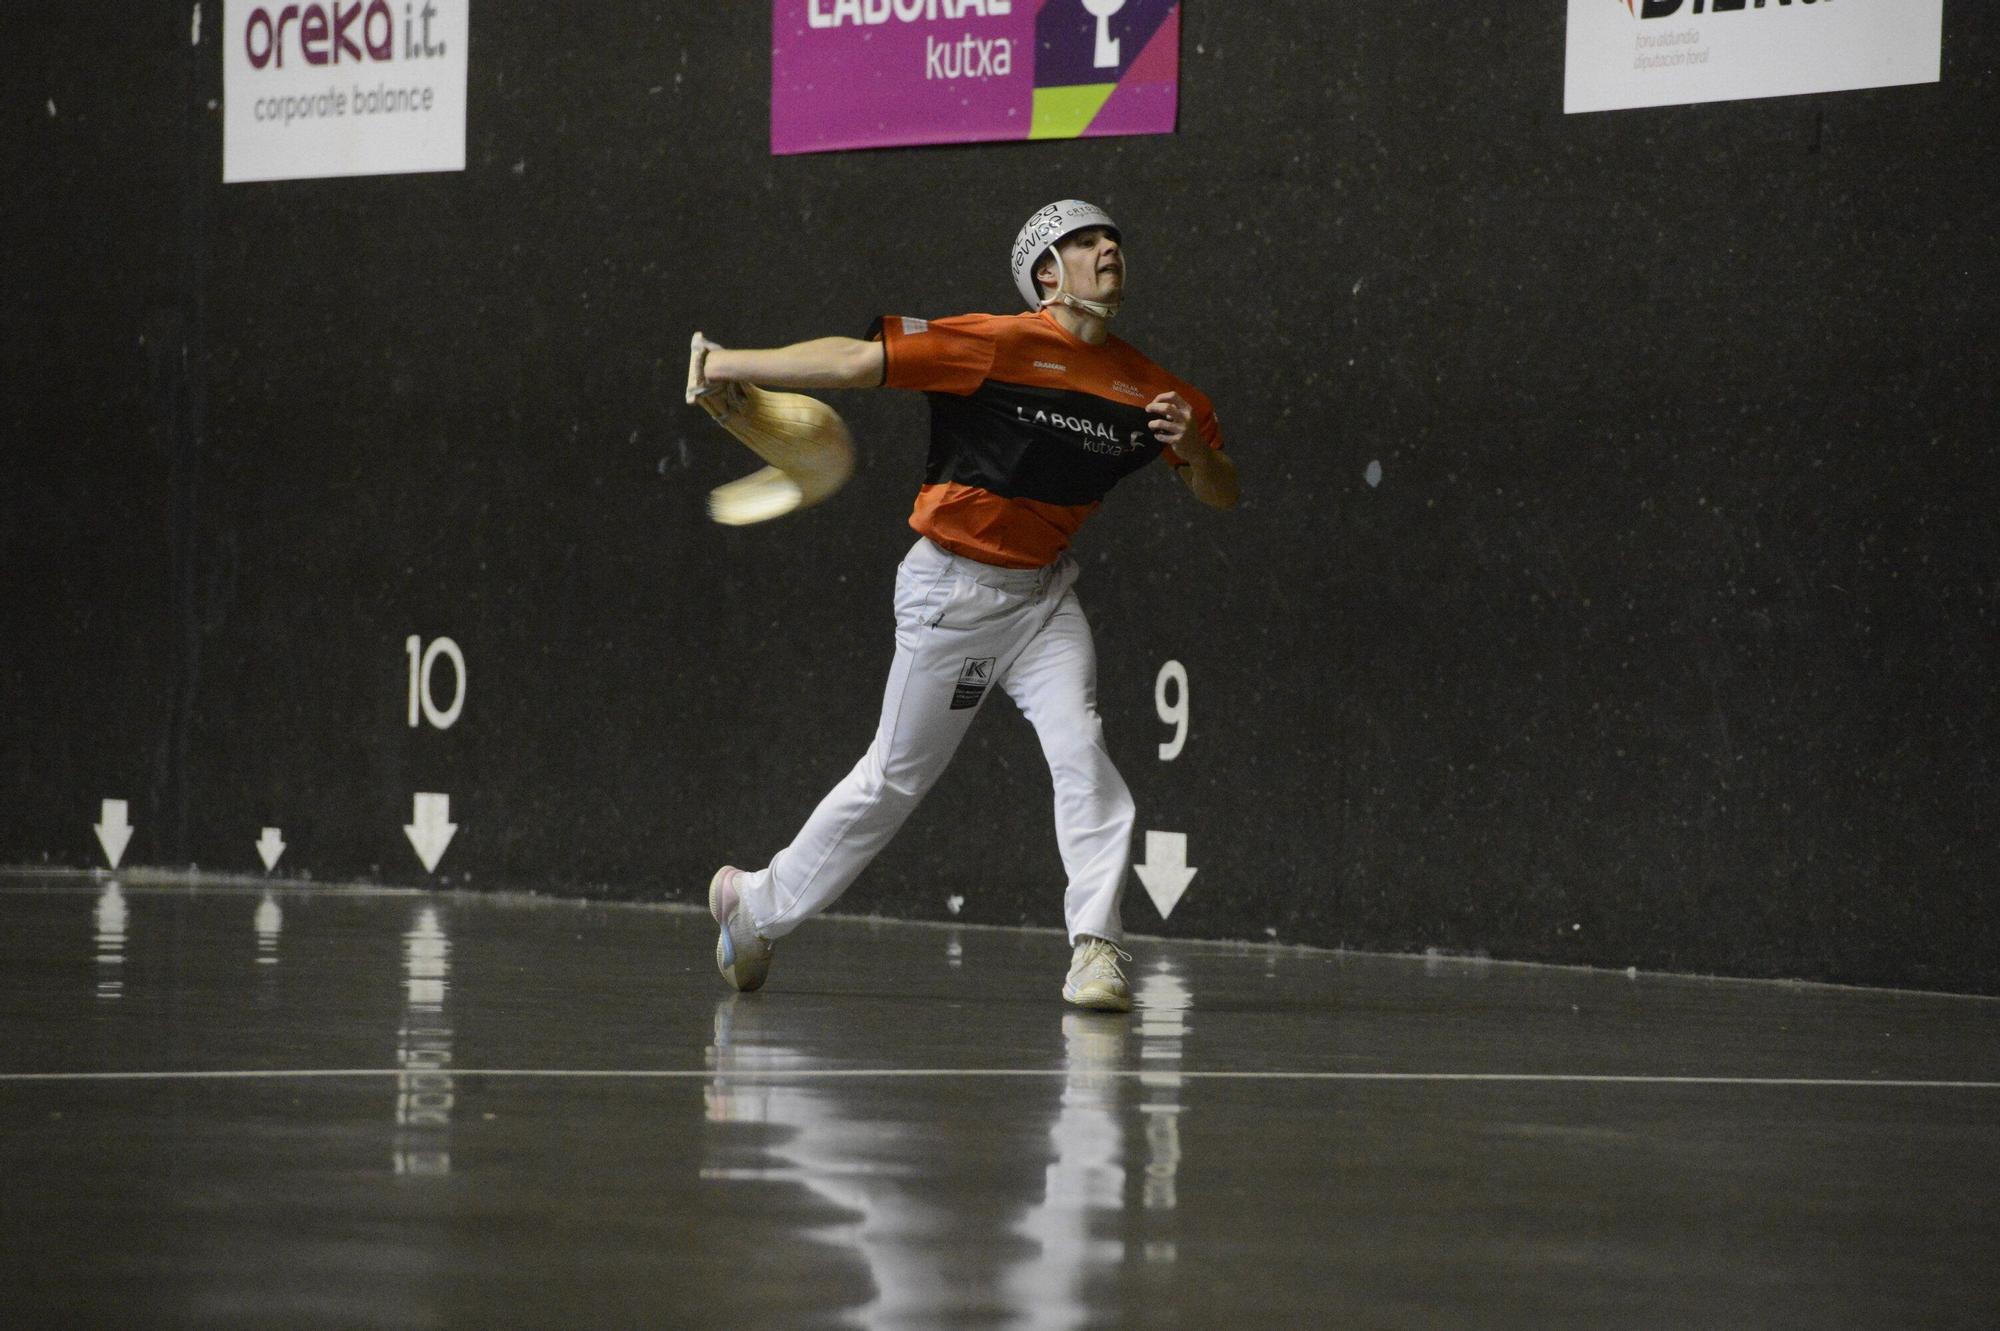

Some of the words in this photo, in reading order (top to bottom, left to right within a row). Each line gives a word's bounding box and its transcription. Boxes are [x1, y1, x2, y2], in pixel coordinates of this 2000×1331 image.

[246, 0, 393, 69] oreka
[404, 1, 447, 59] i.t.
[926, 33, 1011, 80] kutxa
[254, 86, 347, 126] corporate
[353, 82, 434, 115] balance
[1017, 406, 1119, 442] LABORAL
[1083, 438, 1122, 456] kutxa
[405, 634, 467, 730] 10
[1155, 659, 1189, 761] 9
